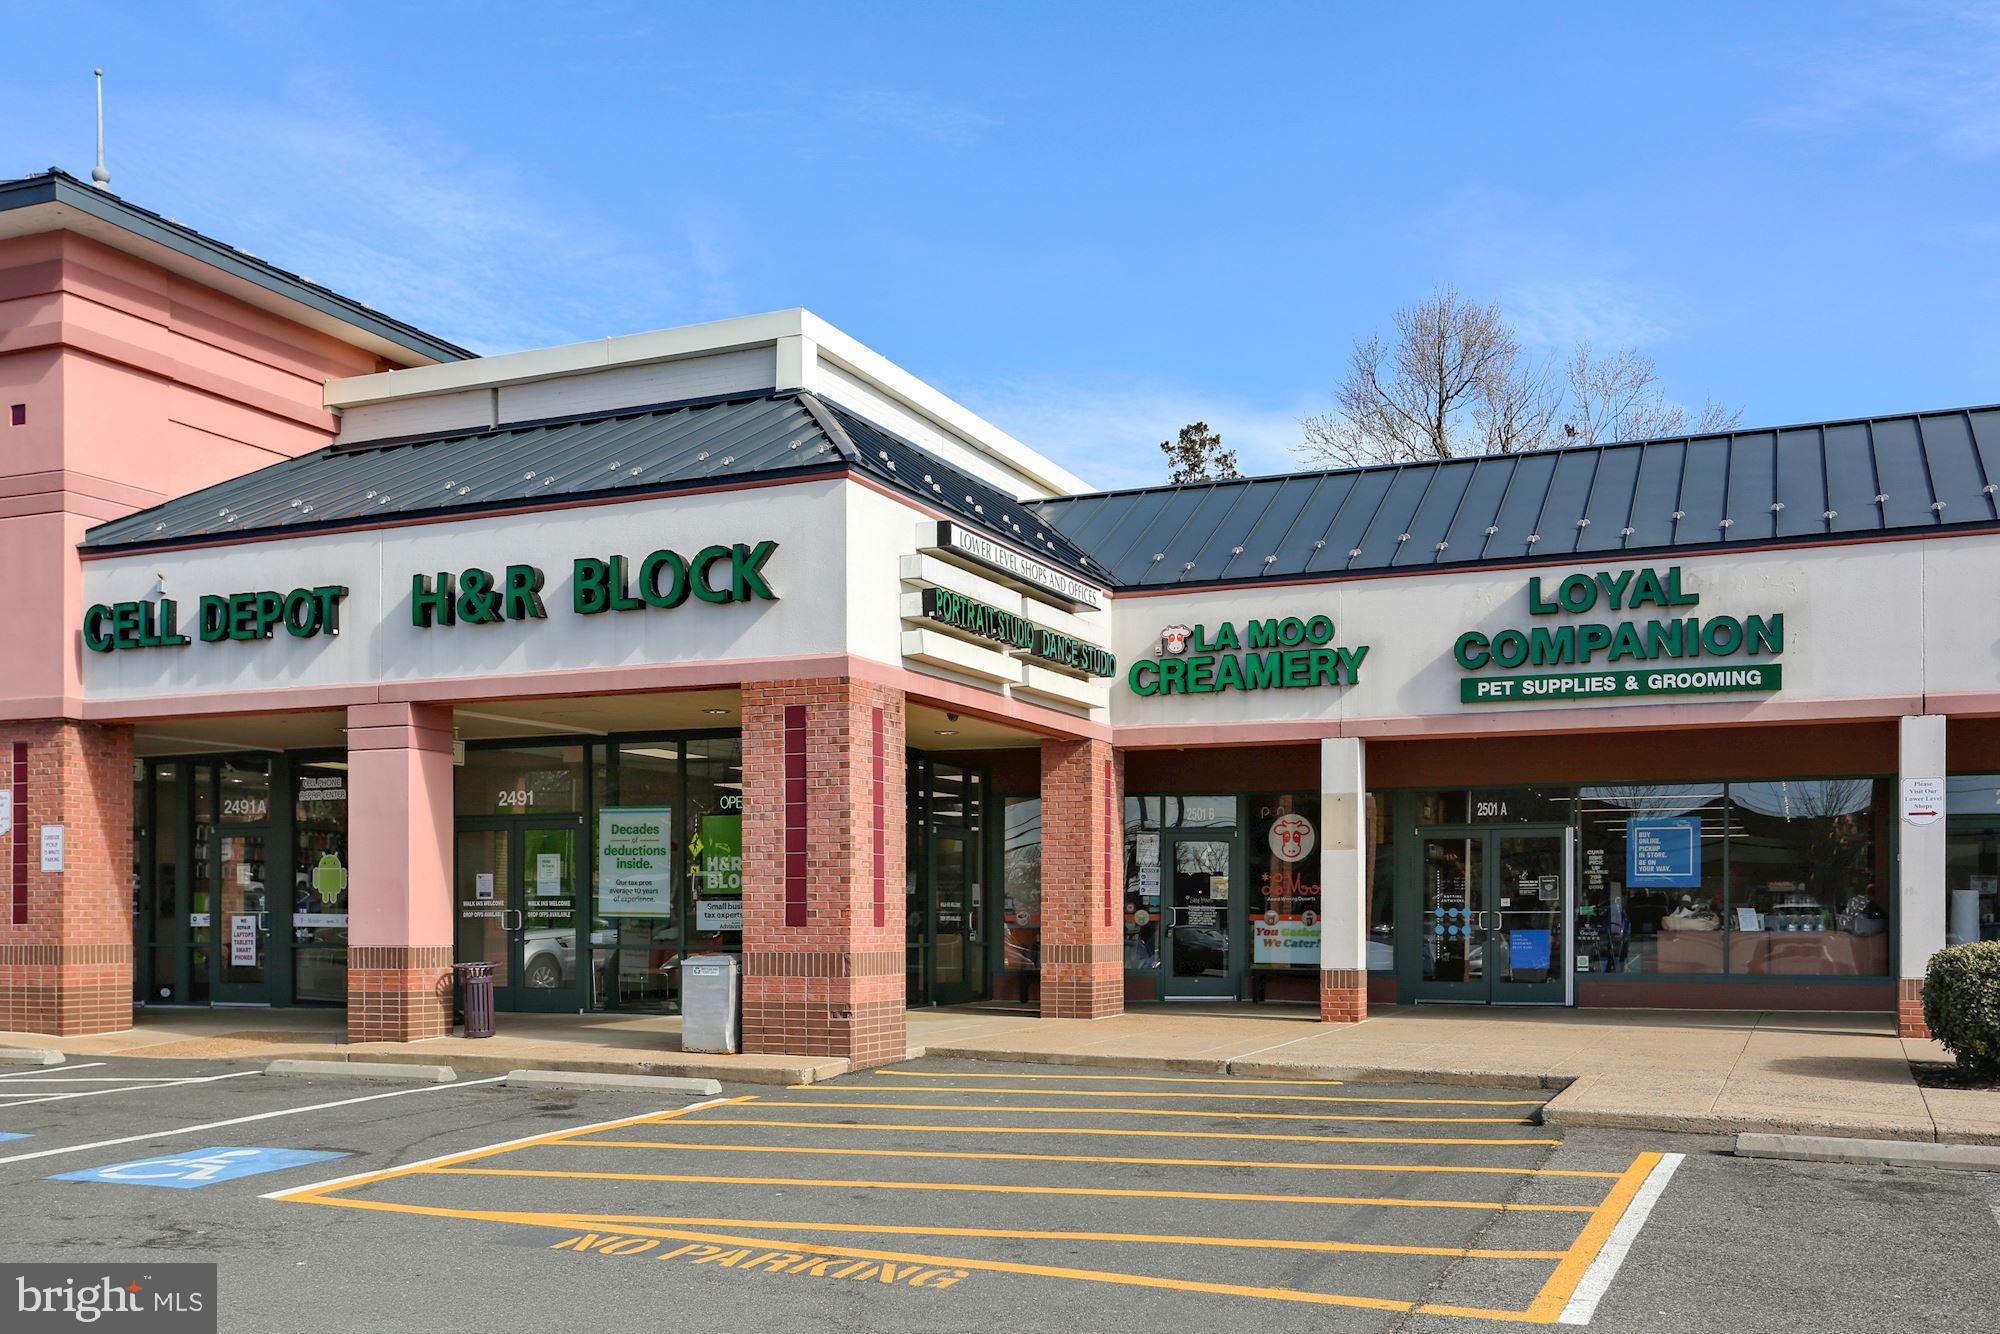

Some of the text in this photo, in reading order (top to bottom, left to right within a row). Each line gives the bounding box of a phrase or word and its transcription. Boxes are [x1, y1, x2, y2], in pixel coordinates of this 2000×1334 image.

[960, 531, 1096, 605] LOWER LEVEL SHOPS AND OFFICES
[412, 541, 780, 627] H&R BLOCK
[1529, 566, 1699, 615] LOYAL
[84, 585, 348, 653] CELL DEPOT
[935, 588, 1035, 648] PORTRAIT STUDIO
[1194, 615, 1335, 652] LA MOO
[1454, 613, 1783, 669] COMPANION
[1043, 630, 1117, 677] DANCE STUDIO
[1128, 646, 1370, 696] CREAMERY
[1477, 670, 1761, 696] PET SUPPLIES & GROOMING
[299, 789, 346, 801] REPAIR CENTER
[498, 790, 534, 806] 2491
[720, 796, 742, 809] OPE
[224, 800, 266, 814] 2491A
[1186, 807, 1215, 820] 2501 B
[1477, 802, 1507, 816] 2501 A
[611, 824, 659, 834] Decades
[604, 844, 666, 855] deductions
[616, 857, 653, 869] inside.
[707, 856, 742, 872] H&R
[707, 873, 742, 889] BLO
[1256, 928, 1279, 936] You
[1263, 939, 1320, 948] We Cater!
[550, 1233, 970, 1288] NO PARKING
